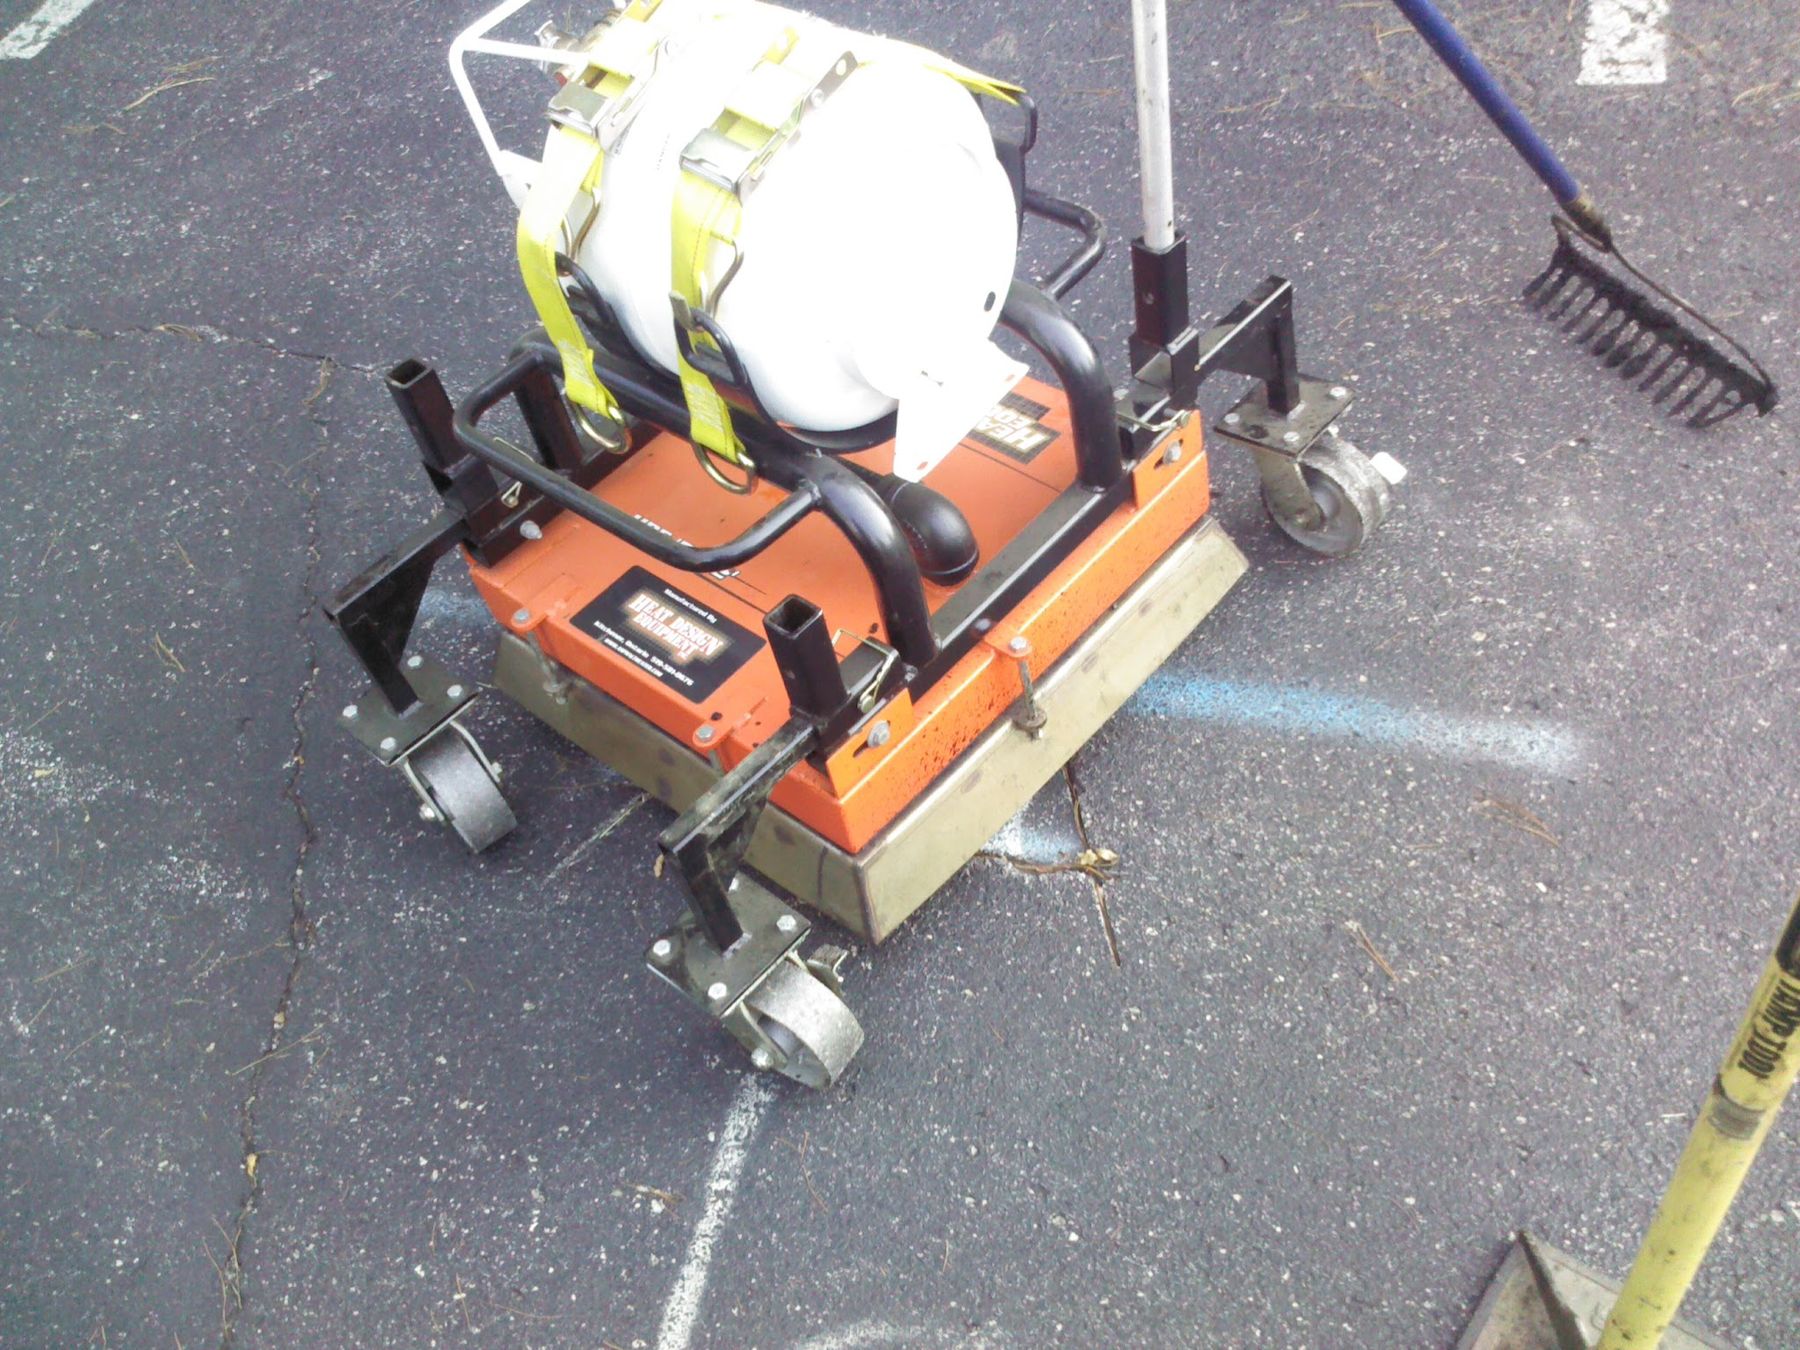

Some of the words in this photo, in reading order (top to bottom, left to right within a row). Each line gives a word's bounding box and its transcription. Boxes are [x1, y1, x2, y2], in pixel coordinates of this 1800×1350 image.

[975, 414, 1049, 450] HEA
[628, 593, 675, 622] HEAT
[668, 616, 723, 656] DESIGN
[633, 612, 700, 655] EQUIPMENT
